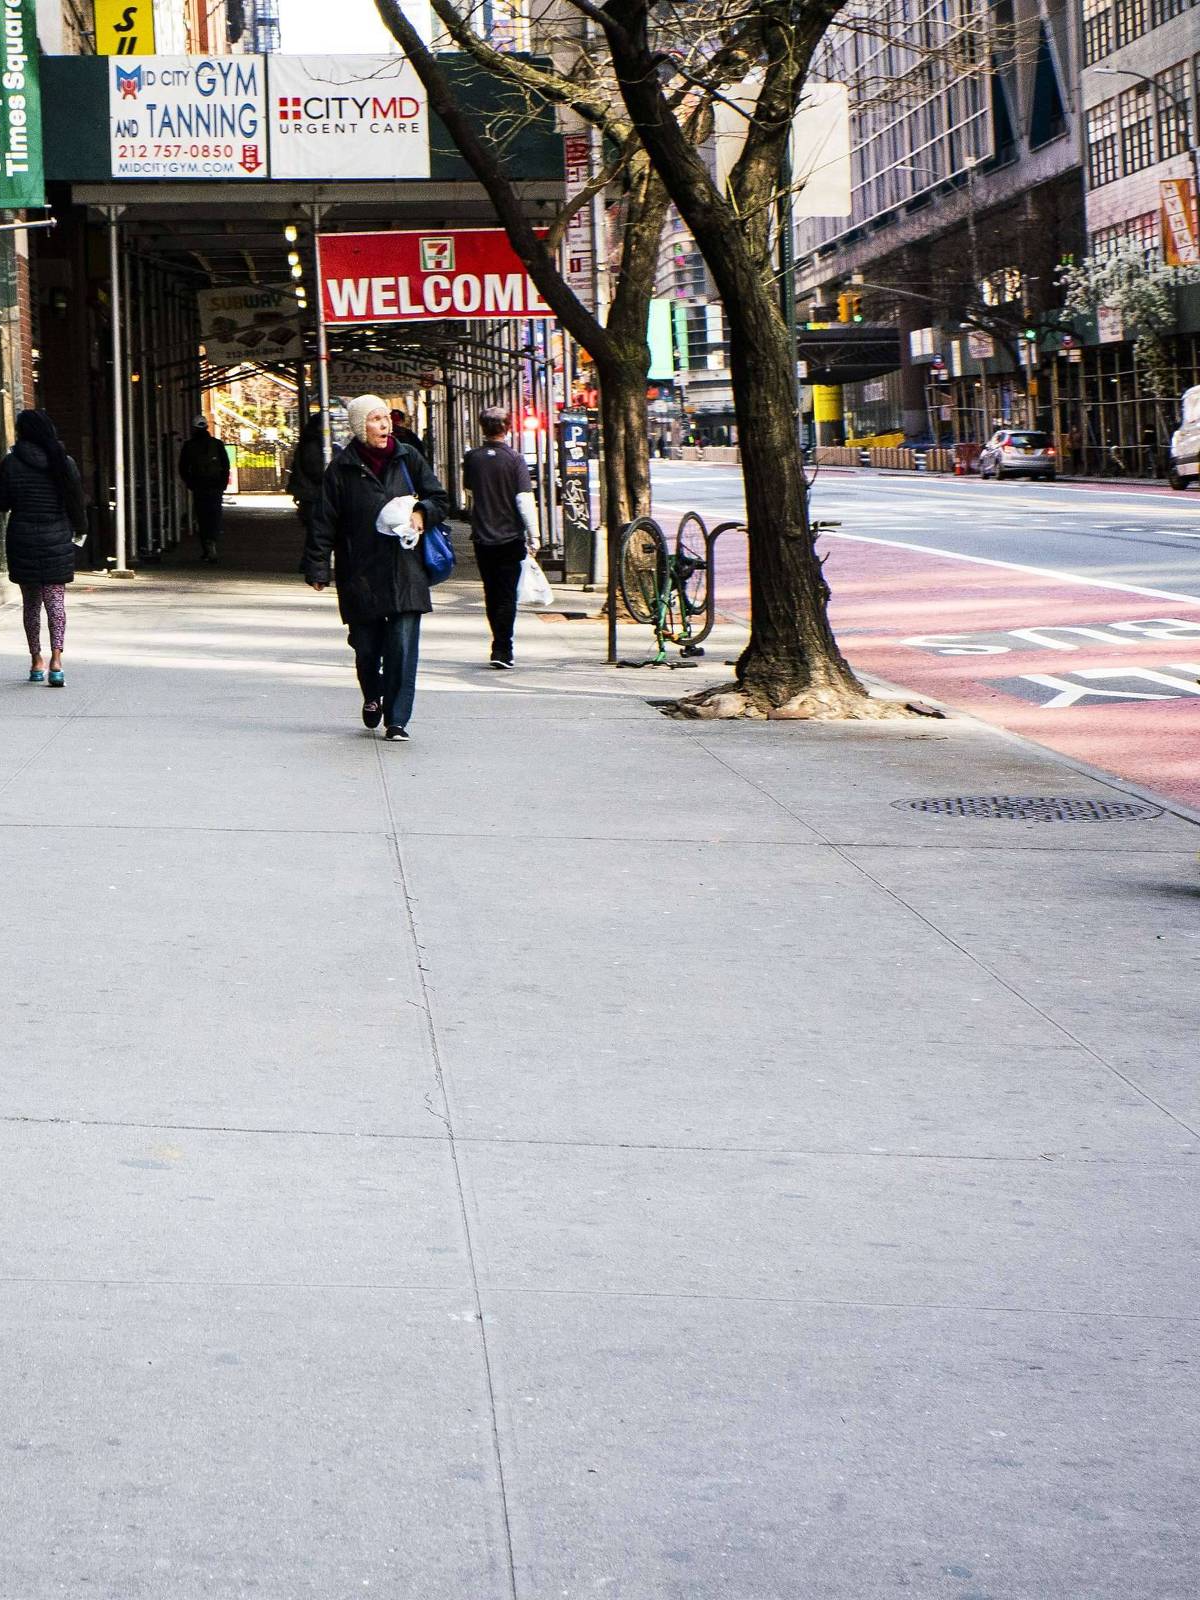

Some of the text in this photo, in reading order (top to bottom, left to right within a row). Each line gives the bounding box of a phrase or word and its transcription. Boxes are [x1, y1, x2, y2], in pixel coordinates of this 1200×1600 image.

[161, 70, 189, 86] CITY
[195, 61, 258, 97] GYM
[304, 97, 420, 119] CITYMD
[115, 103, 258, 138] AND TANNING
[280, 123, 420, 134] URGENT CARE
[6, 95, 29, 177] Times
[118, 144, 234, 158] 212 757-0850
[118, 162, 234, 173] MIDCITYGYM.COM
[571, 426, 582, 442] P
